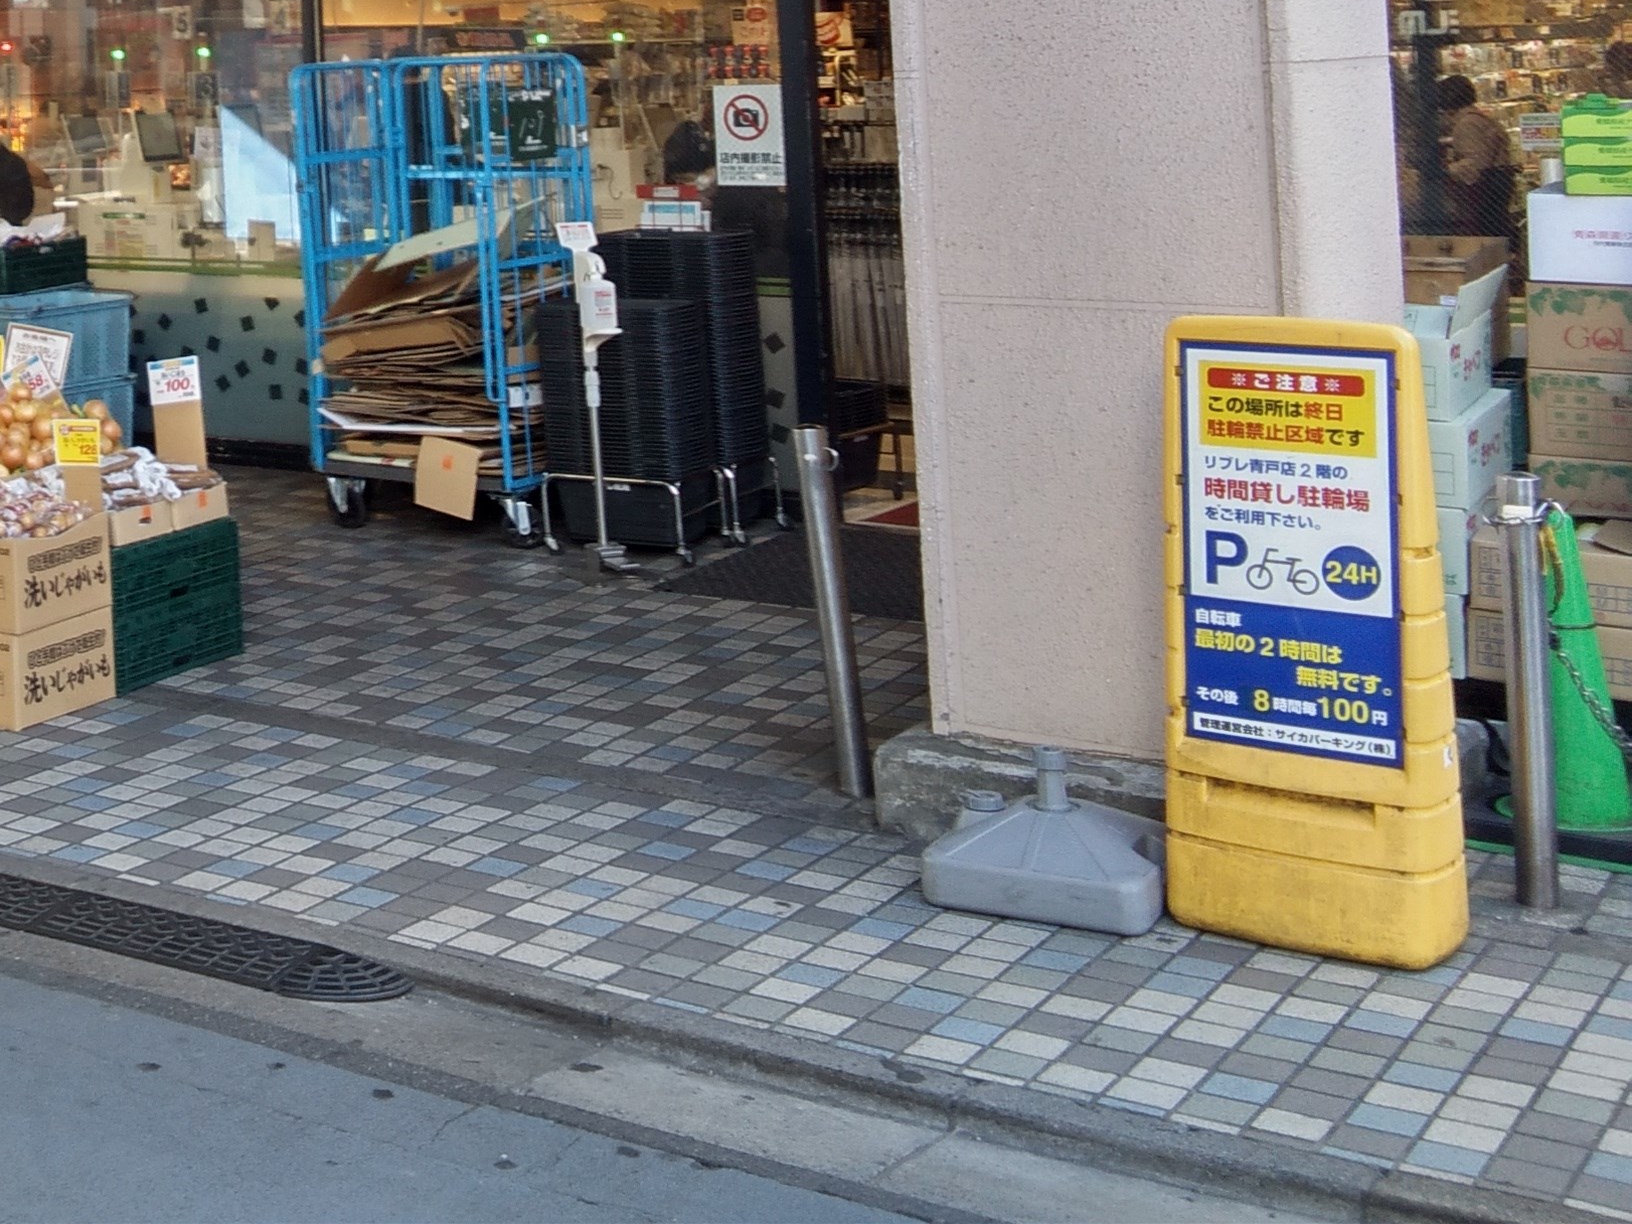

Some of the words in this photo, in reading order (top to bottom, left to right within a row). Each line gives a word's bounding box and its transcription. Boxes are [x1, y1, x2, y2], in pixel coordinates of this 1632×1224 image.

[720, 151, 782, 164] 店内撮影禁止
[164, 377, 191, 392] 100
[1208, 396, 1344, 422] この場所は終日
[1207, 419, 1365, 447] 駐輪禁止区域です
[1204, 477, 1371, 513] 時間貸し駐輪場
[1204, 505, 1322, 531] をご利用下さい。
[1205, 530, 1249, 585] P
[24, 560, 107, 609] 洗いじゃがいも
[1325, 561, 1378, 585] 24H
[1195, 608, 1243, 628] 自転車
[1194, 627, 1343, 664] 最初の2時間は
[24, 653, 111, 705] 洗いじゃがいも
[1296, 666, 1393, 697] 無料です。
[1196, 686, 1240, 706] その後
